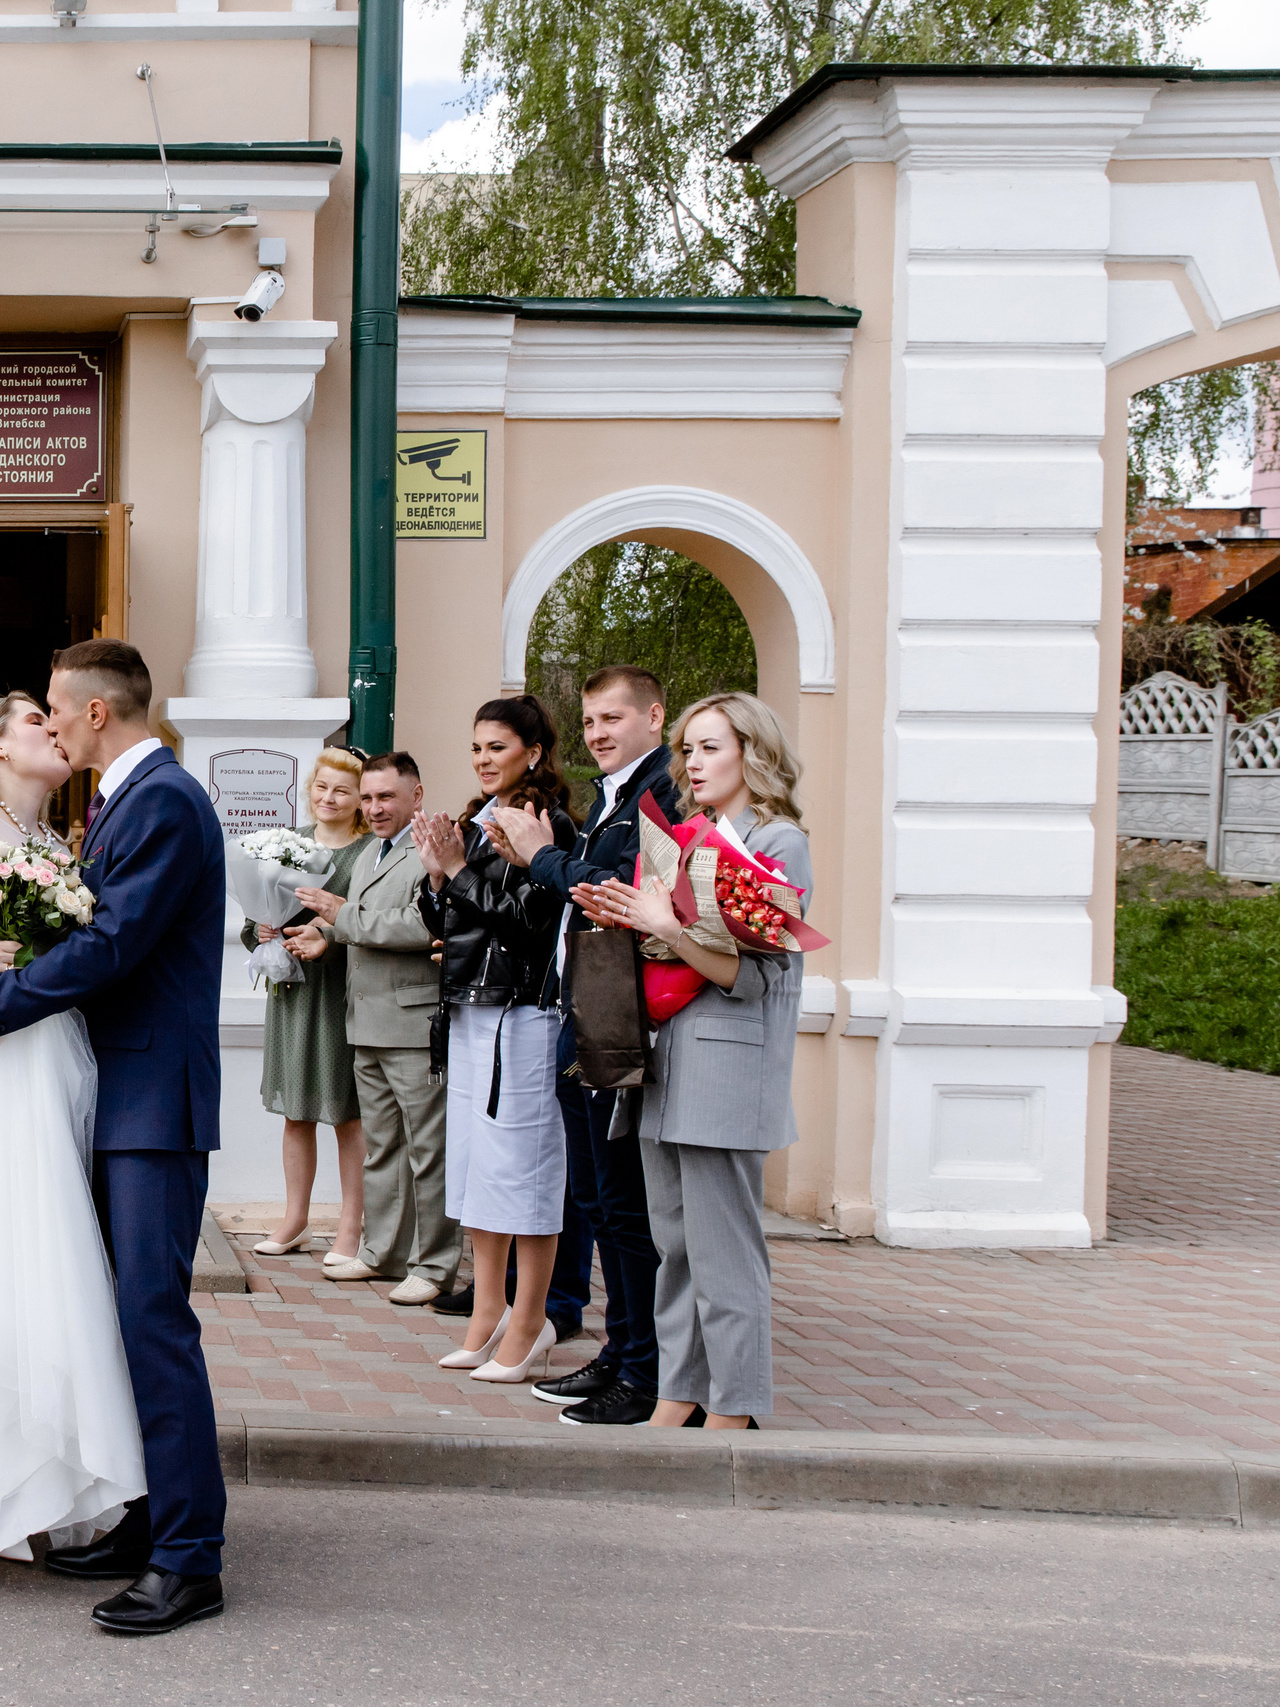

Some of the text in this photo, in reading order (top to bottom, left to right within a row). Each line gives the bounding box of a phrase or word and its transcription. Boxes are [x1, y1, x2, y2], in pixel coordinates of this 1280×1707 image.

[23, 364, 77, 375] городской
[53, 405, 91, 417] района
[46, 437, 87, 449] АКТОВ
[404, 493, 479, 503] ТЕРРИТОРИИ
[407, 506, 455, 518] ВЕДЁТСЯ
[396, 521, 482, 532] ДЕОНАБЛЮДЕНИЕ
[227, 809, 277, 817] БУДЫНАК
